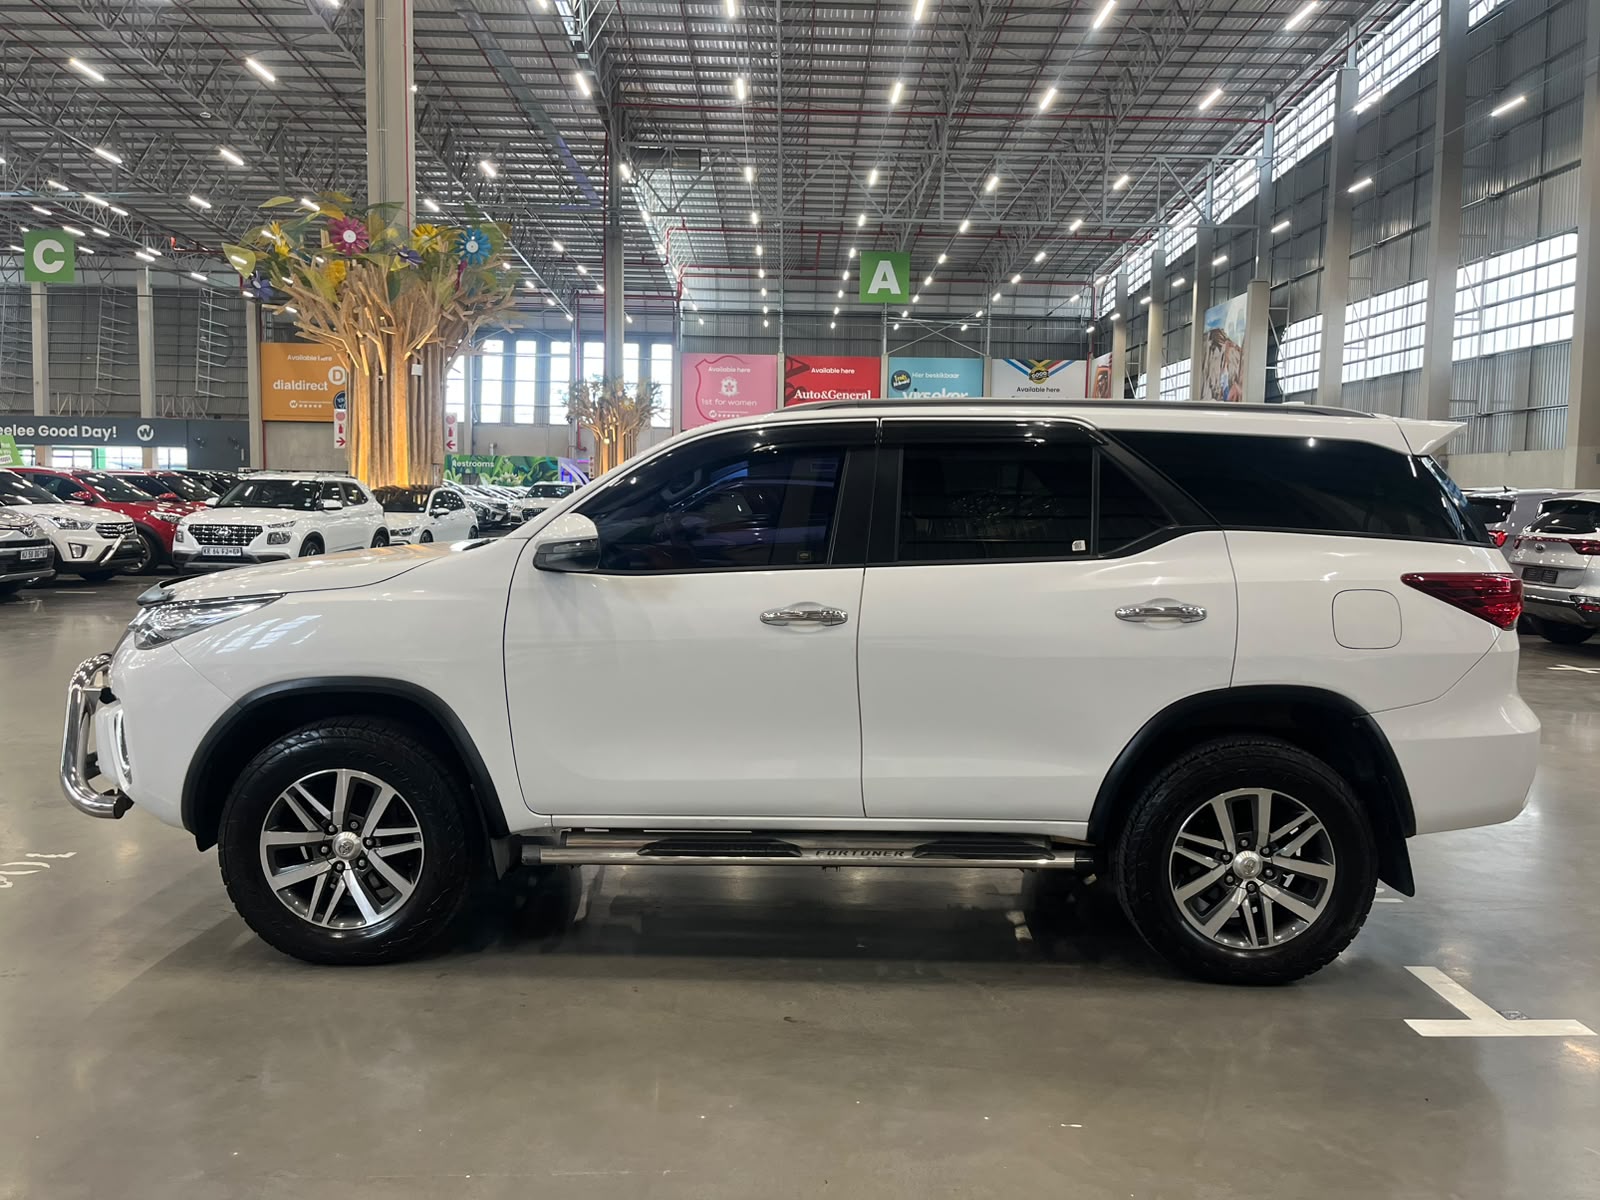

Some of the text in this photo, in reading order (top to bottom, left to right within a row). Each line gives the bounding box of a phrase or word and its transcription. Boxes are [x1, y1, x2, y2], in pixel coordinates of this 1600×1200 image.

[33, 239, 65, 274] C
[867, 260, 901, 294] A
[273, 379, 329, 391] dialdirect
[794, 389, 872, 400] Auto&General
[701, 398, 712, 406] 1st
[714, 398, 726, 406] for
[38, 425, 78, 437] Good
[82, 425, 117, 441] Day!
[452, 459, 495, 468] Restrooms
[815, 849, 905, 857] FORTUNER
